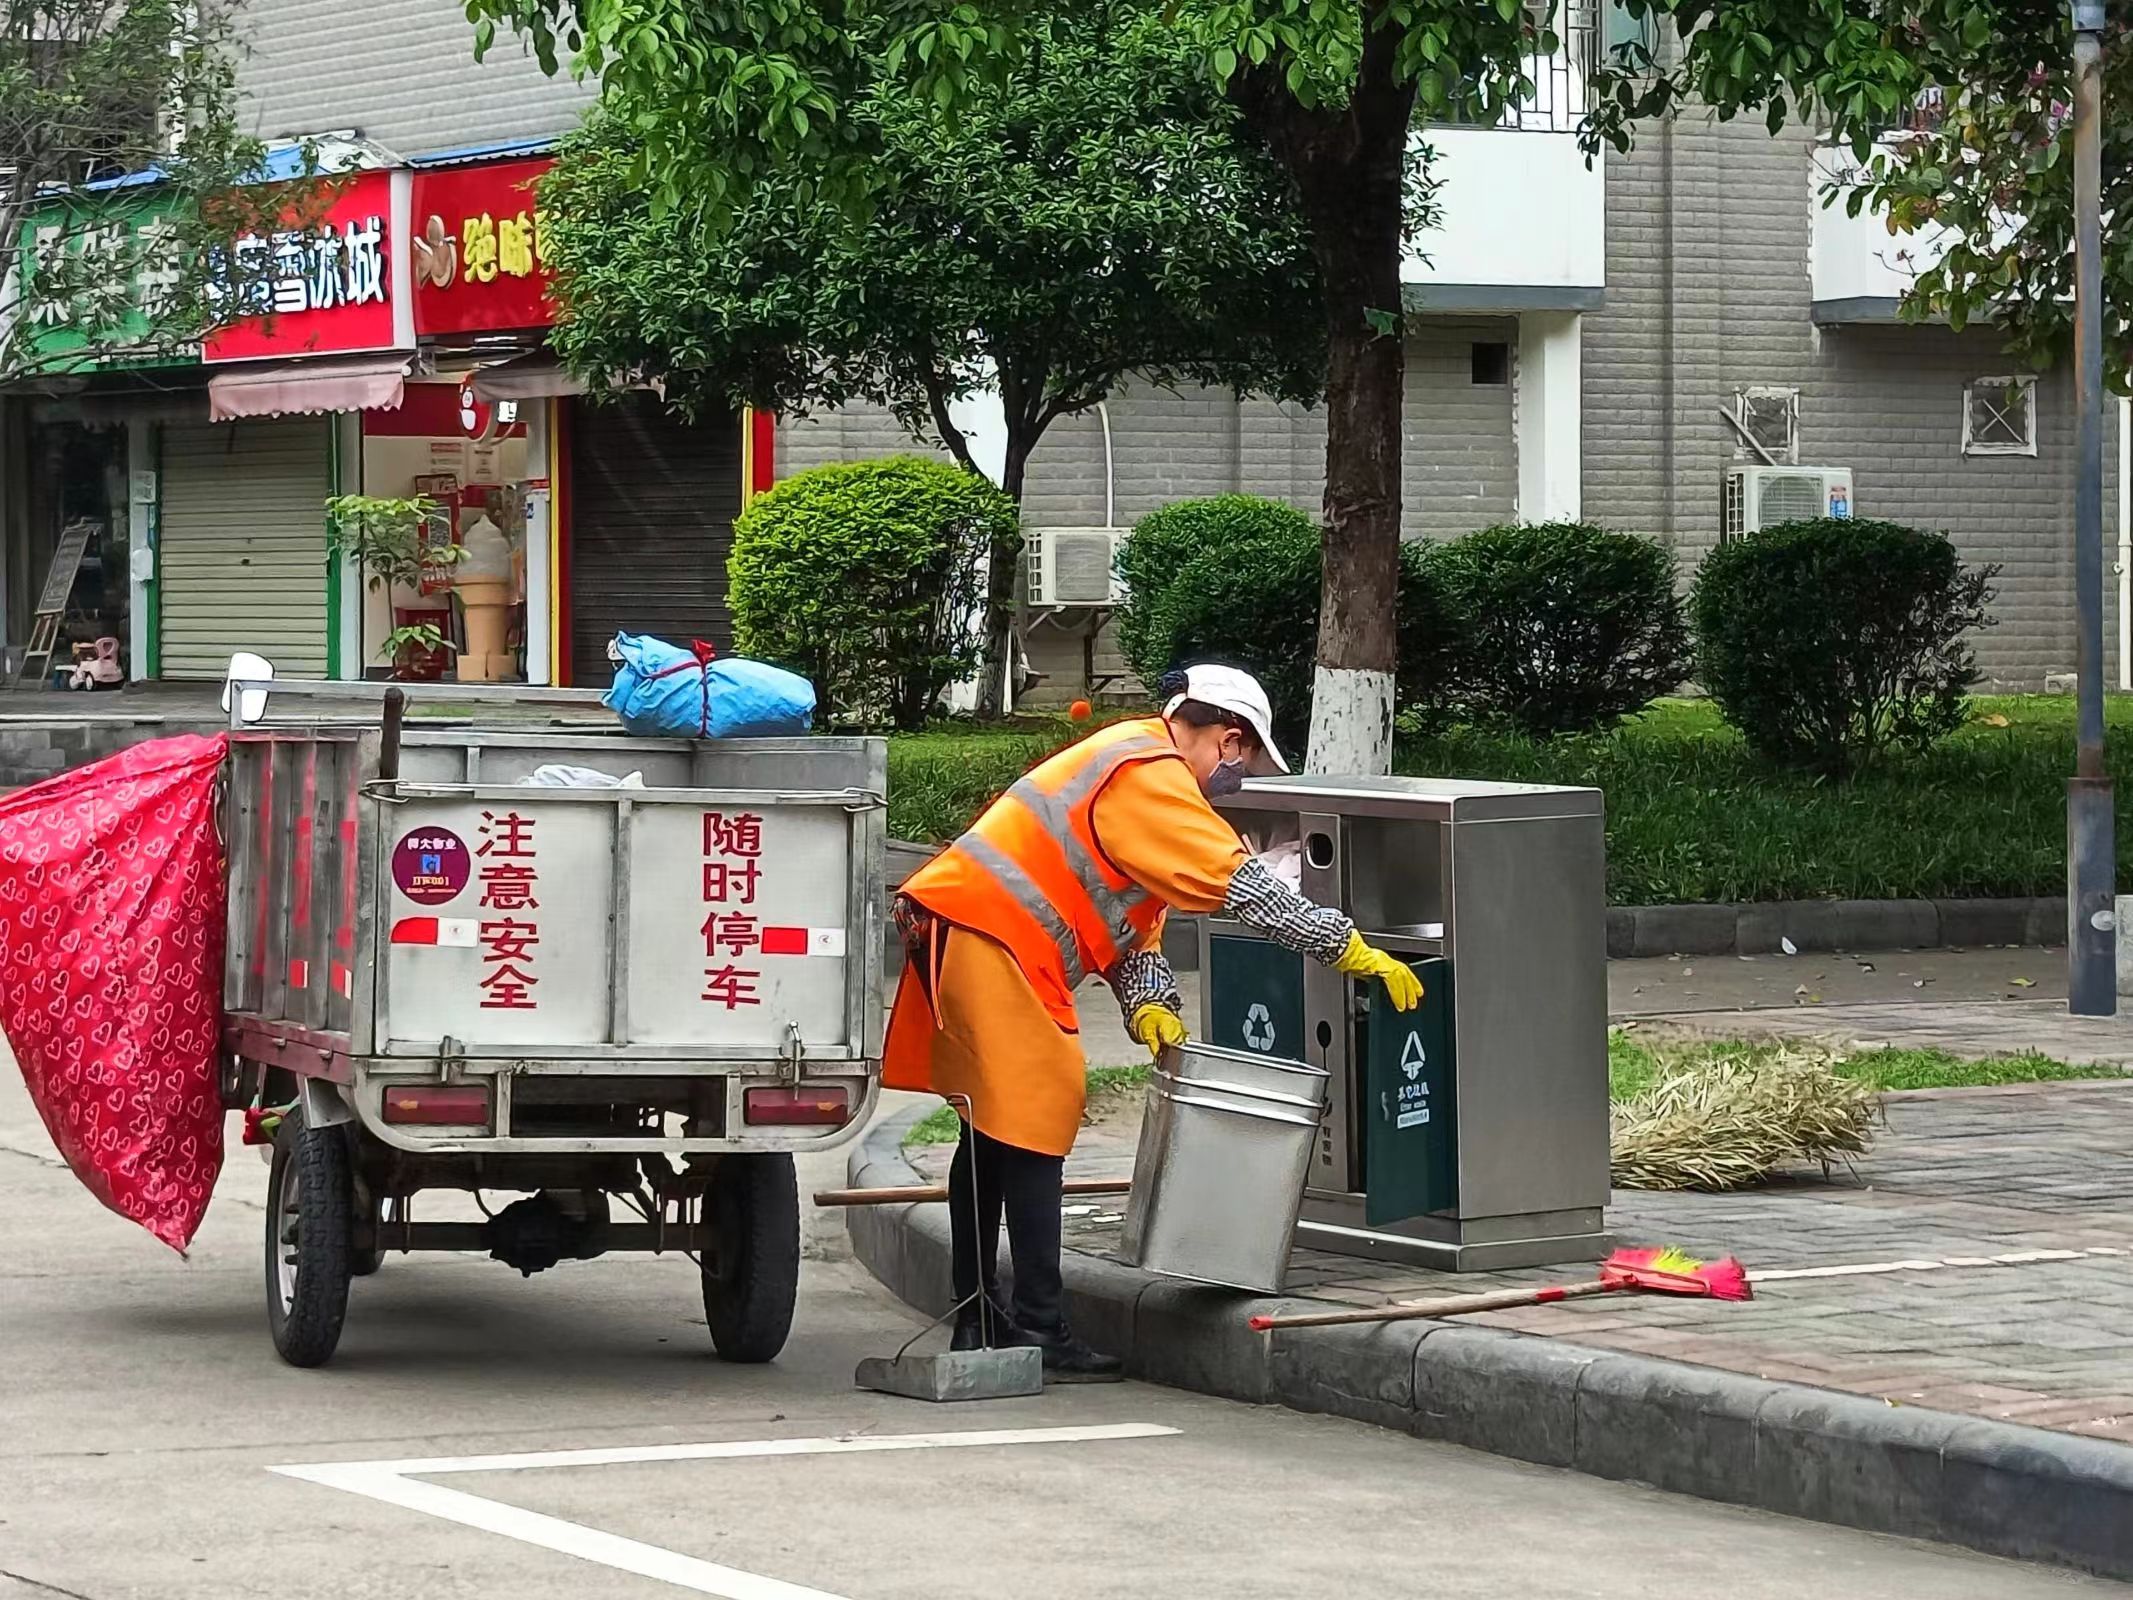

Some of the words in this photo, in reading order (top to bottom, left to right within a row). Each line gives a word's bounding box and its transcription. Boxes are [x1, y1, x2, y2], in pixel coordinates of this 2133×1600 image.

[474, 811, 540, 1009] 注意安全
[700, 812, 764, 1010] 随时停车
